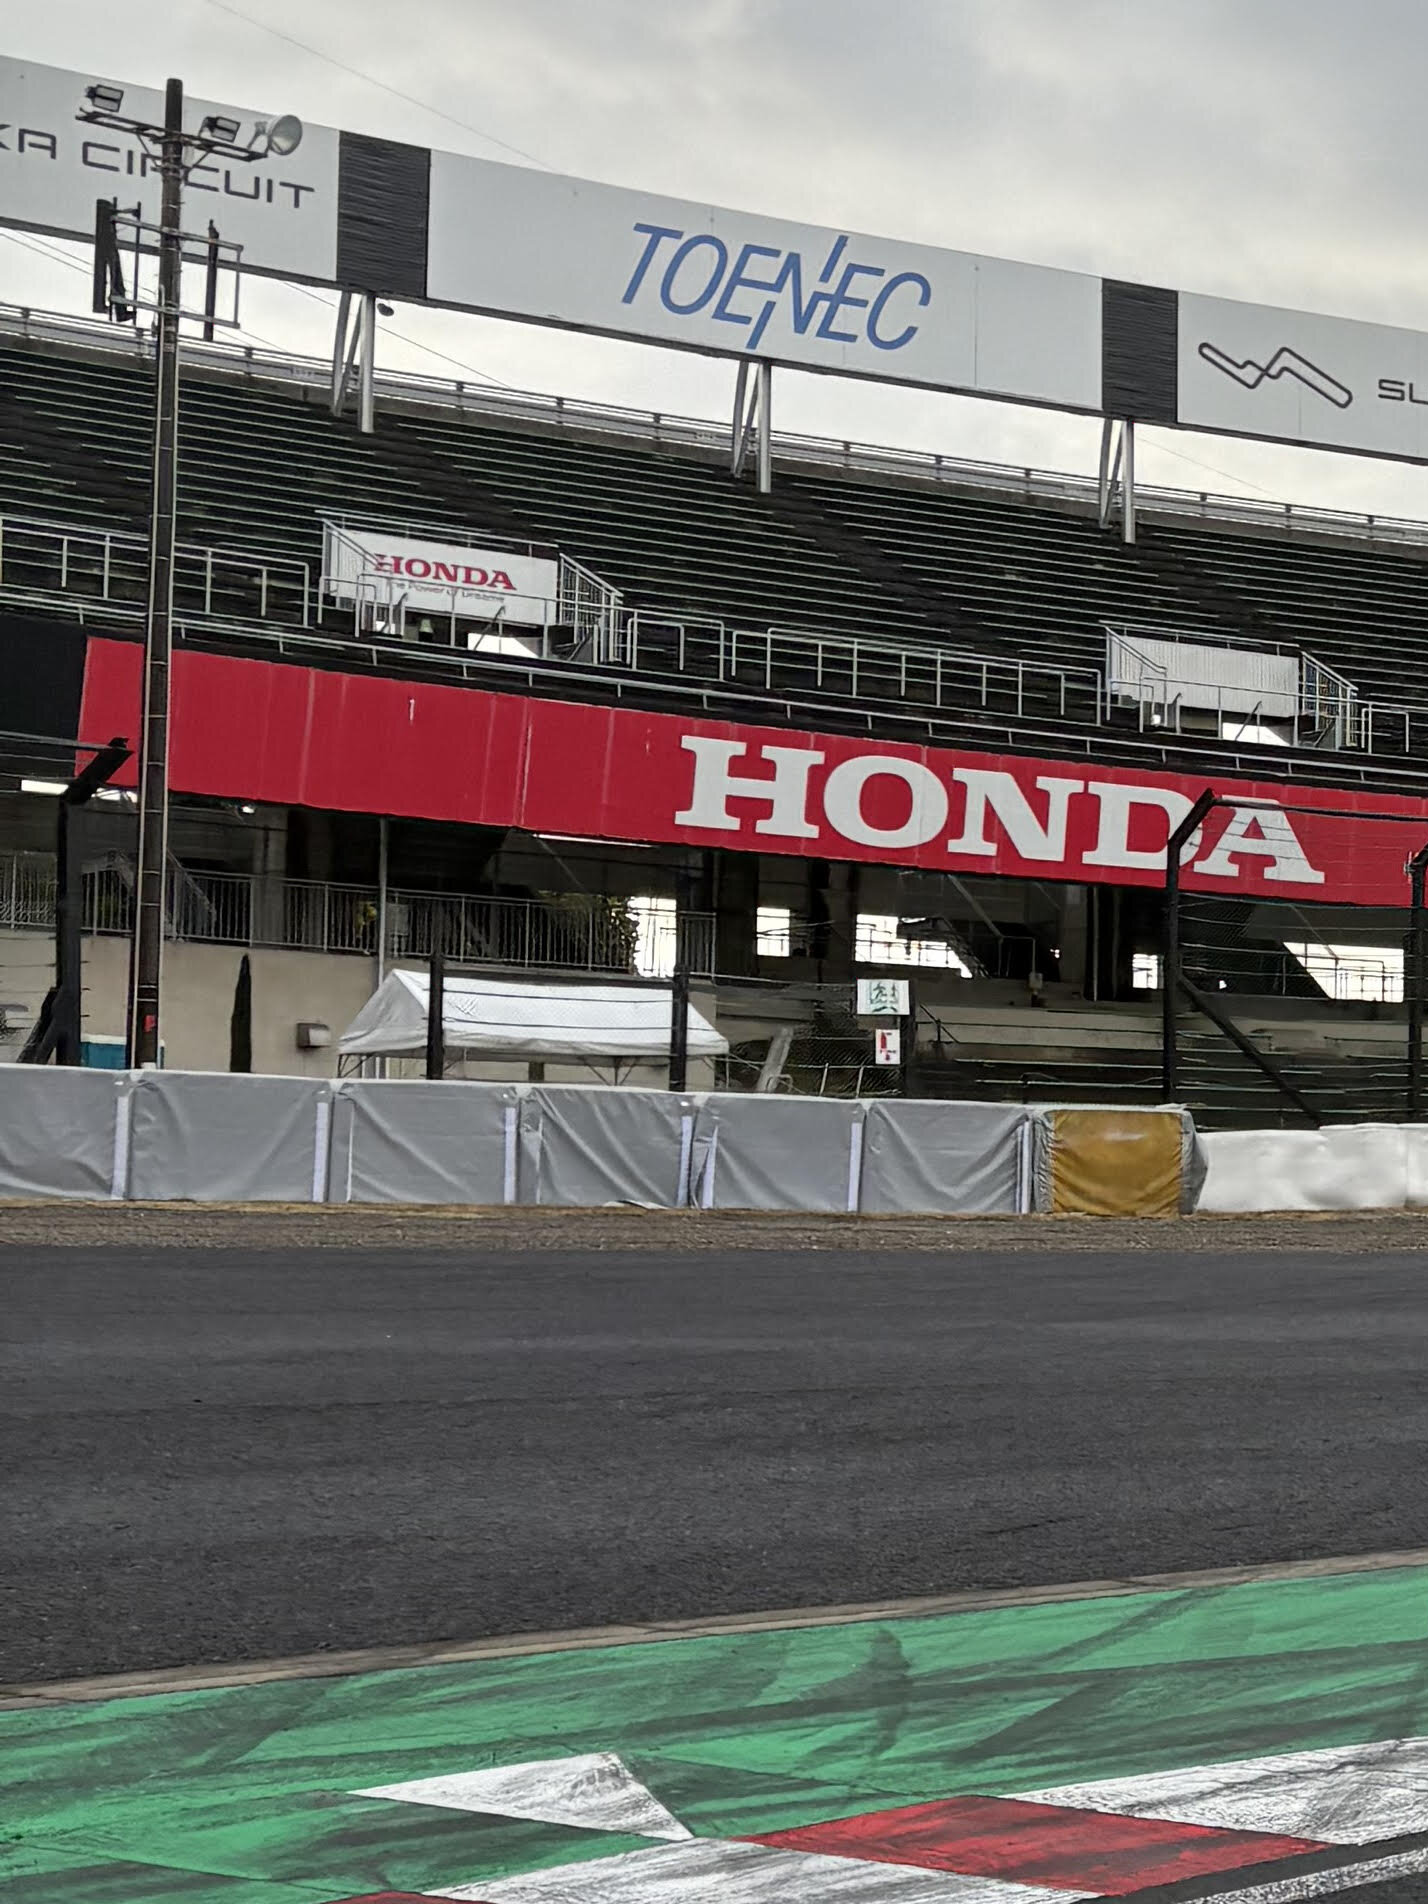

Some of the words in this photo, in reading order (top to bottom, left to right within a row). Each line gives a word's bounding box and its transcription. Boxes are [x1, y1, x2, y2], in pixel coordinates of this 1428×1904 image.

[621, 222, 932, 351] TOENEC
[374, 553, 518, 591] HONDA
[674, 734, 1326, 884] HONDA
